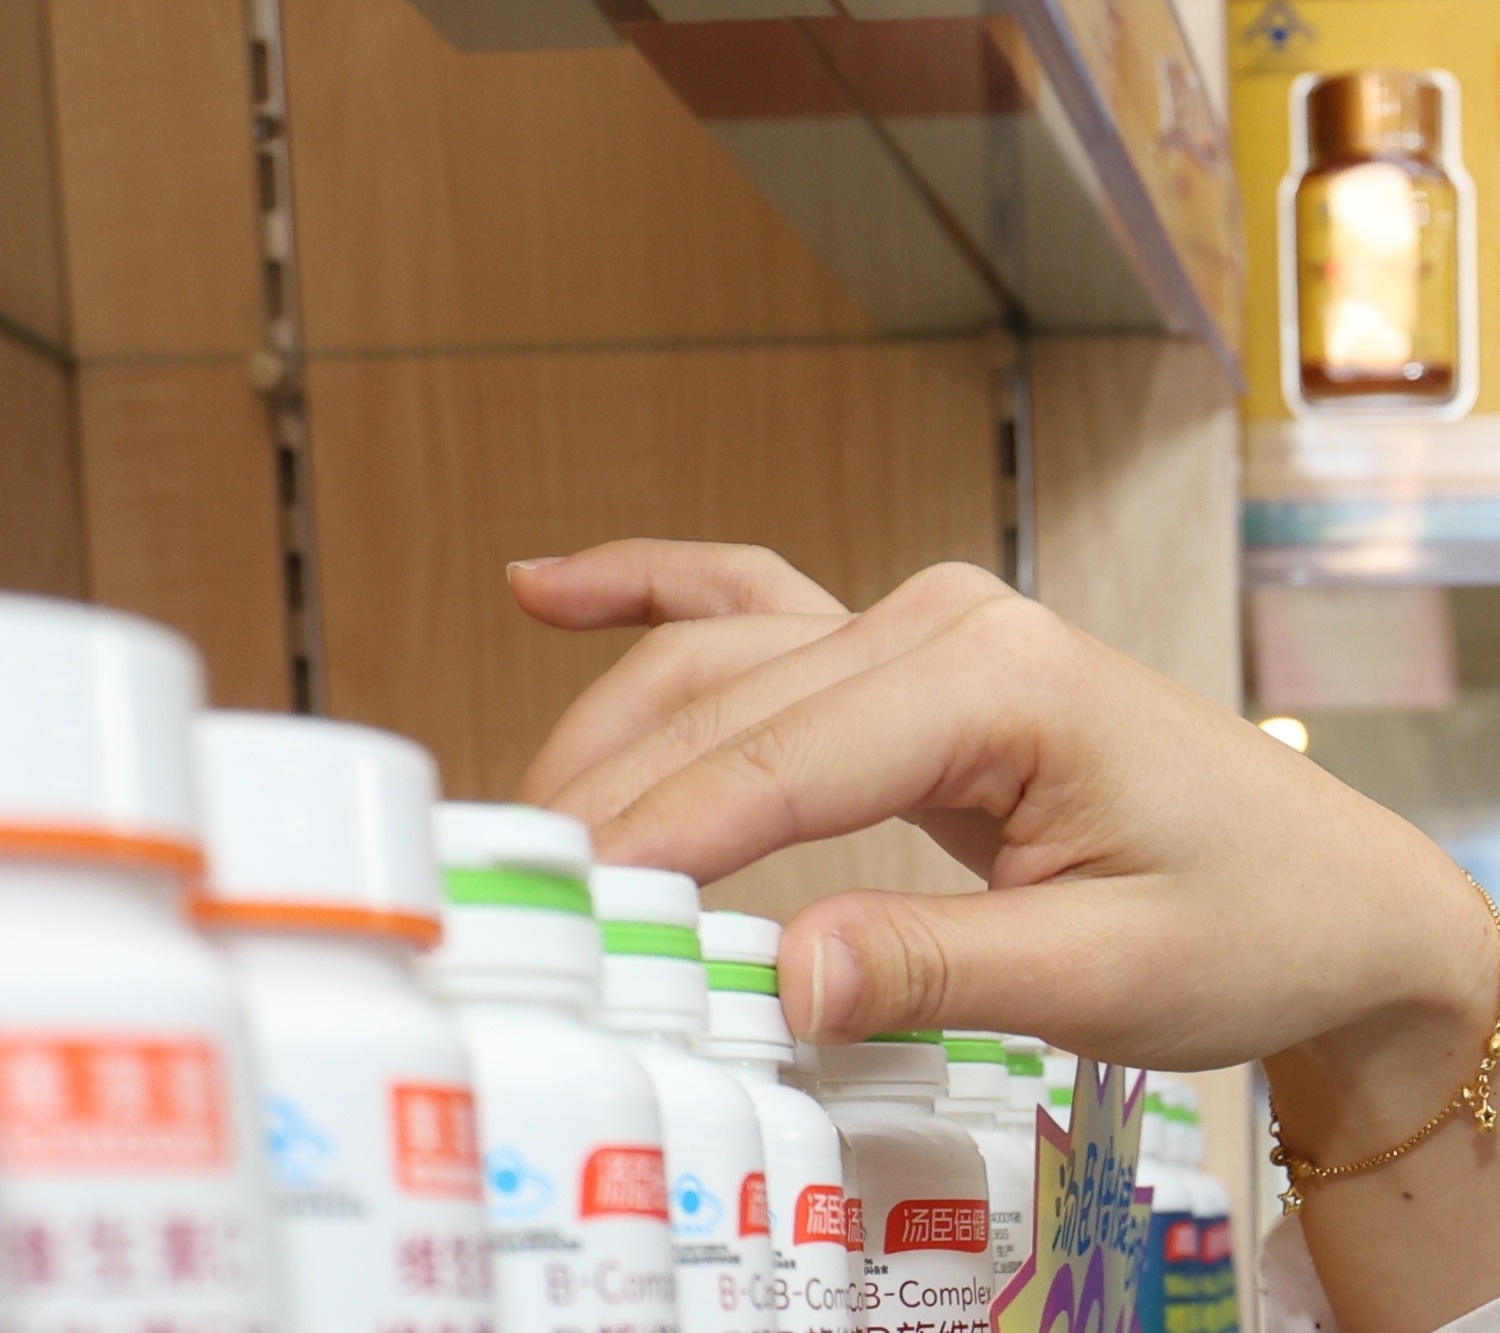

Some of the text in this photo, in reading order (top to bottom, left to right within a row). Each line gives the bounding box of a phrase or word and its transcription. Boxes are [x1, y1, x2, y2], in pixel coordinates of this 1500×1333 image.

[902, 1207, 986, 1243] 汤臣倍健
[865, 1276, 992, 1313] B-Complex
